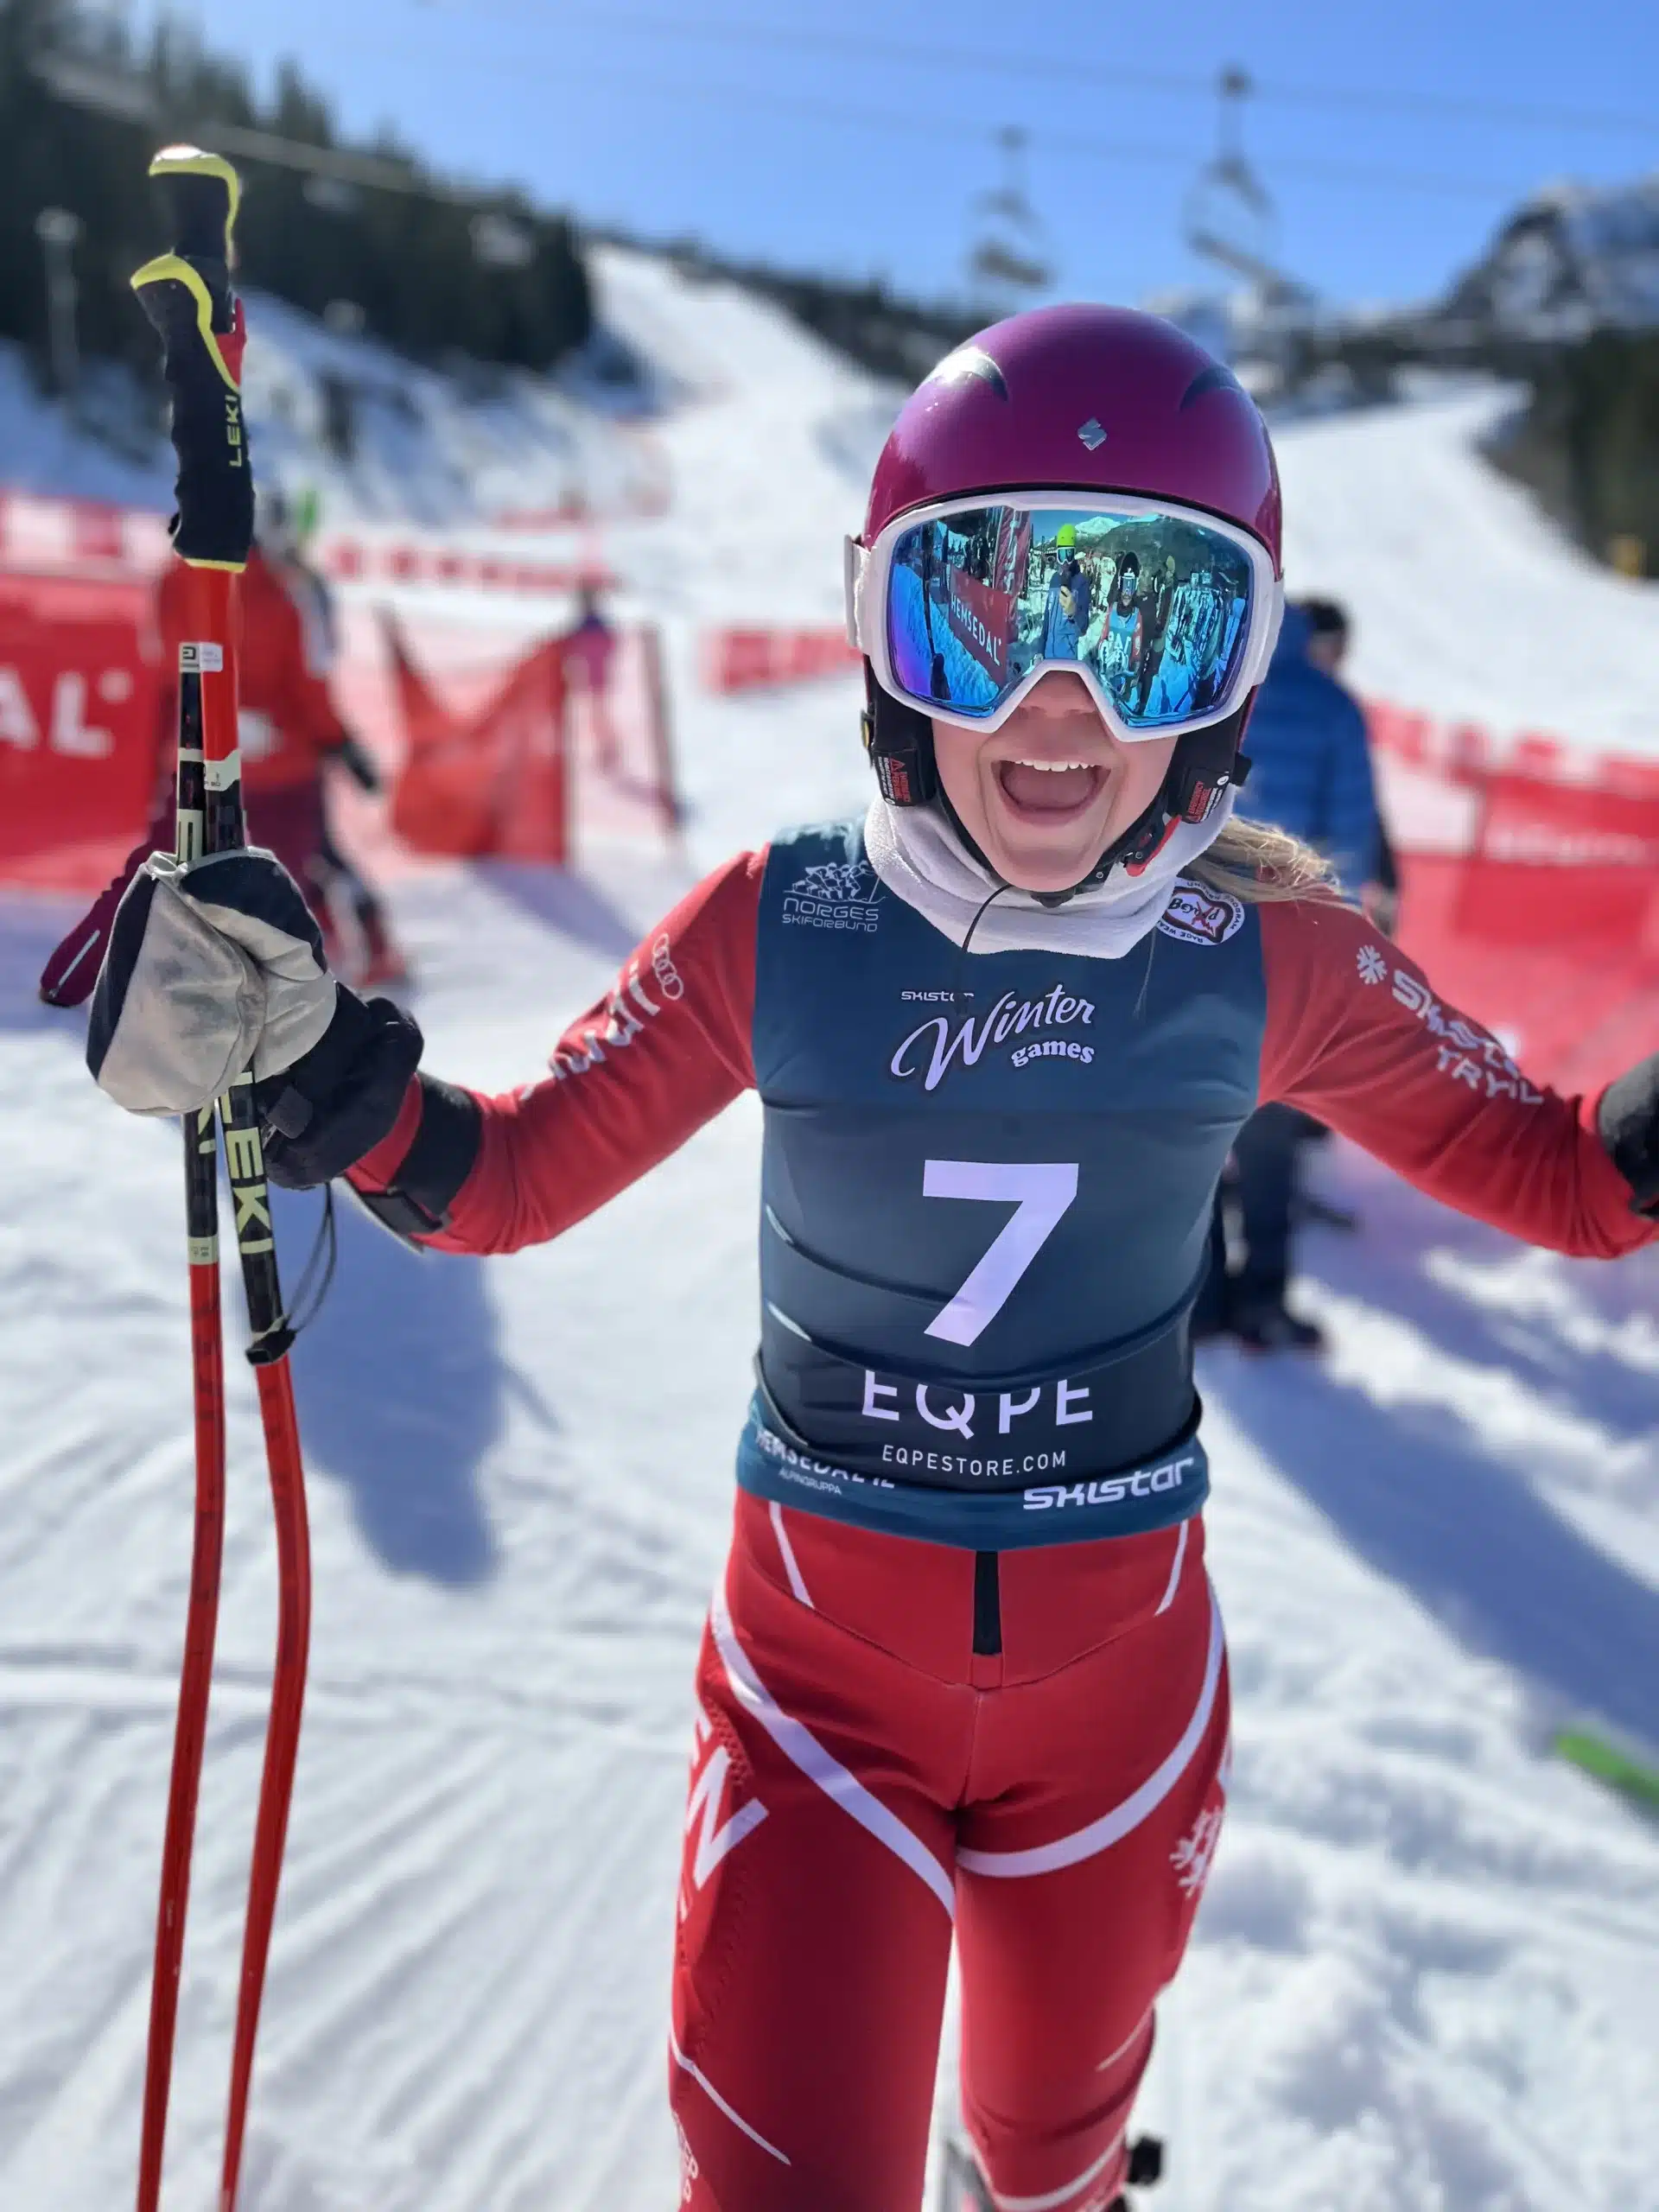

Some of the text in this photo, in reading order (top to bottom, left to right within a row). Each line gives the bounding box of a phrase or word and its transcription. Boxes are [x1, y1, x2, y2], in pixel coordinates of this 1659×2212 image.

[224, 394, 243, 467] LEKI
[951, 593, 1001, 666] HEMSEDAL
[782, 913, 878, 932] SKIFORBUND
[783, 898, 880, 921] NORGES
[891, 983, 1096, 1091] Winter
[1011, 1039, 1095, 1068] games
[922, 1159, 1080, 1348] 7
[861, 1369, 1093, 1440] EQPE
[882, 1444, 1066, 1477] EQPESTORE.COM
